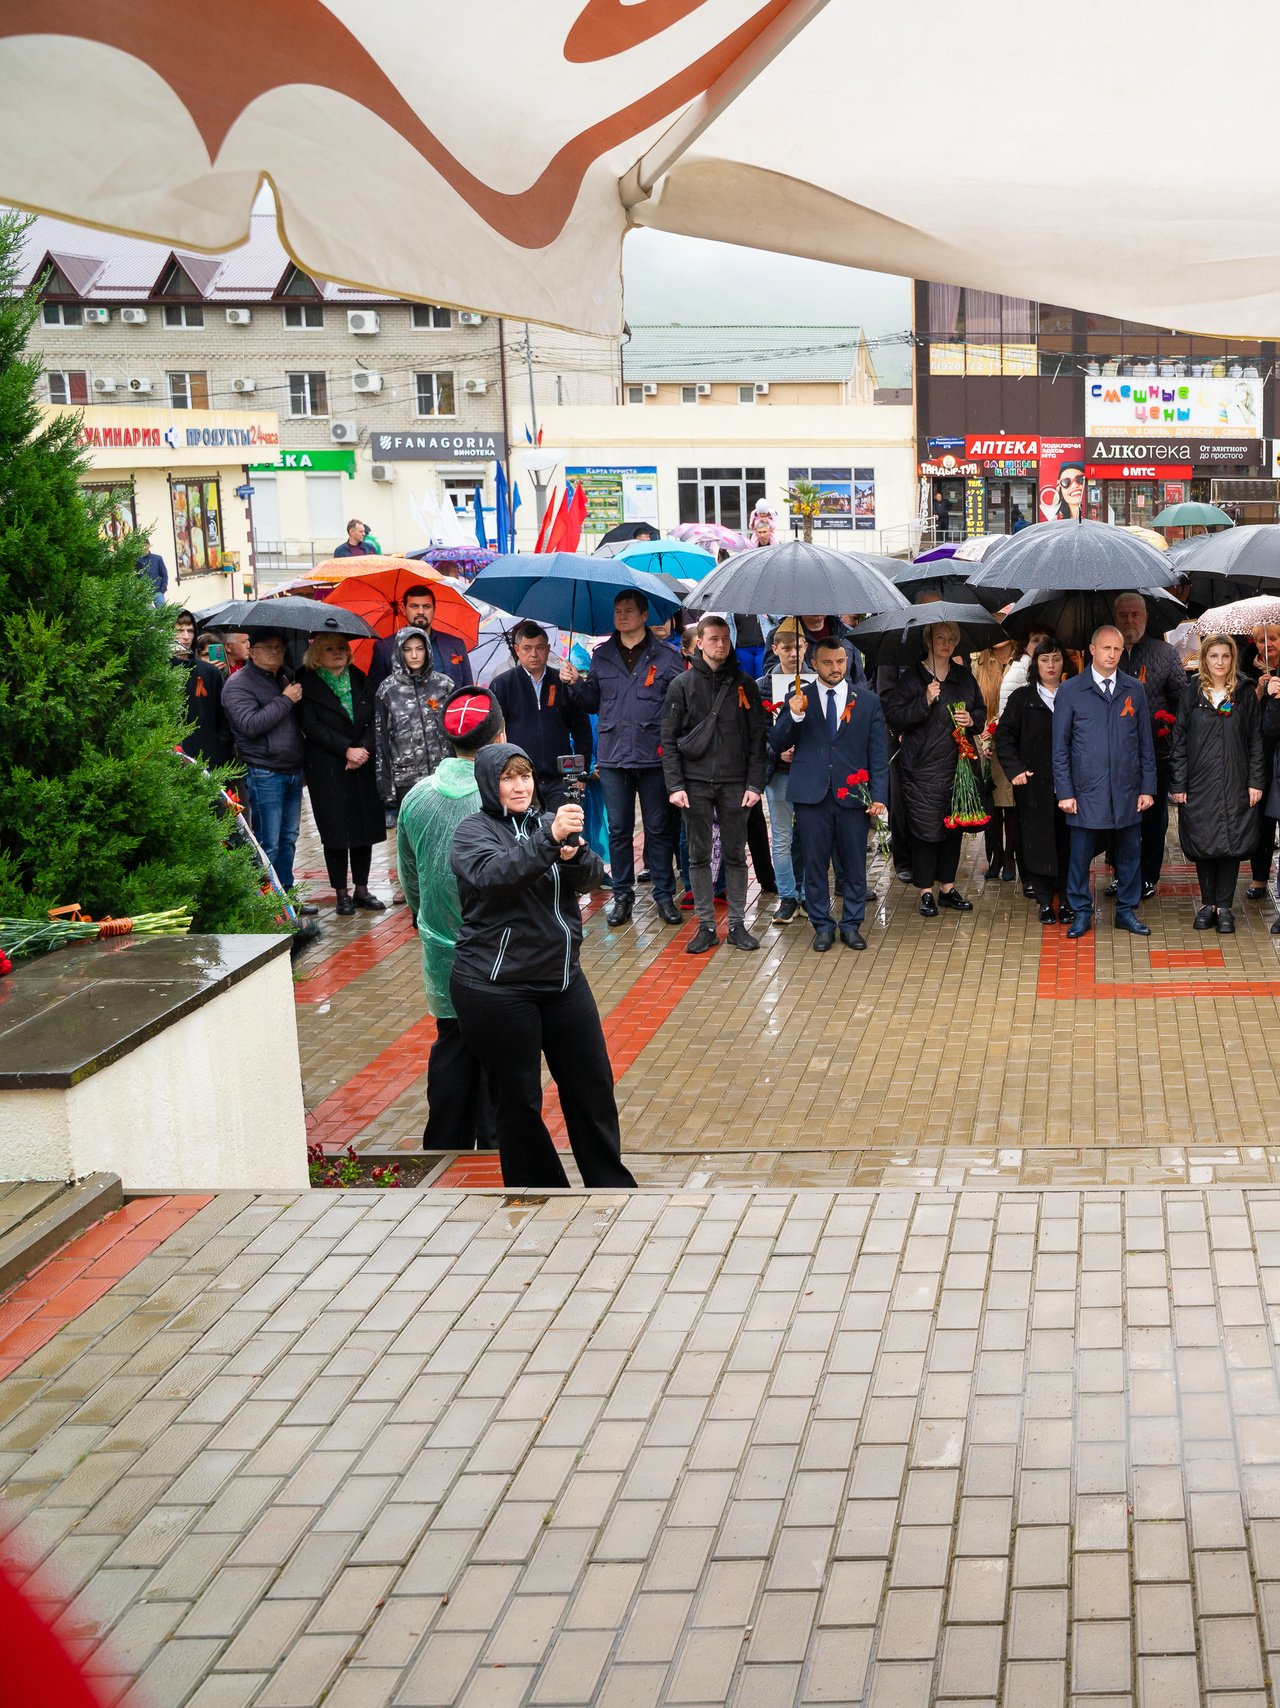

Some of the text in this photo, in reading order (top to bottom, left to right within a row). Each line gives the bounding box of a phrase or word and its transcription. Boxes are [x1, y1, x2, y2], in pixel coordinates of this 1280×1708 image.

[930, 361, 964, 371] 8(928)
[186, 428, 250, 446] ПРОДУКТЫ
[250, 425, 262, 444] 24
[1095, 427, 1250, 436] ОДЕЖДА И ОБУВЬ ДЛЯ ВСЕЙ СЕМЬИ
[395, 437, 495, 448] FANAGORIA
[969, 441, 1038, 454] АПТЕКА
[1092, 441, 1191, 459] Алкотека
[983, 460, 1038, 468] СМЕШНЫЕ
[585, 467, 608, 475] КАРТА
[995, 468, 1027, 476] ЦЕНЫ
[1130, 467, 1156, 476] МТС
